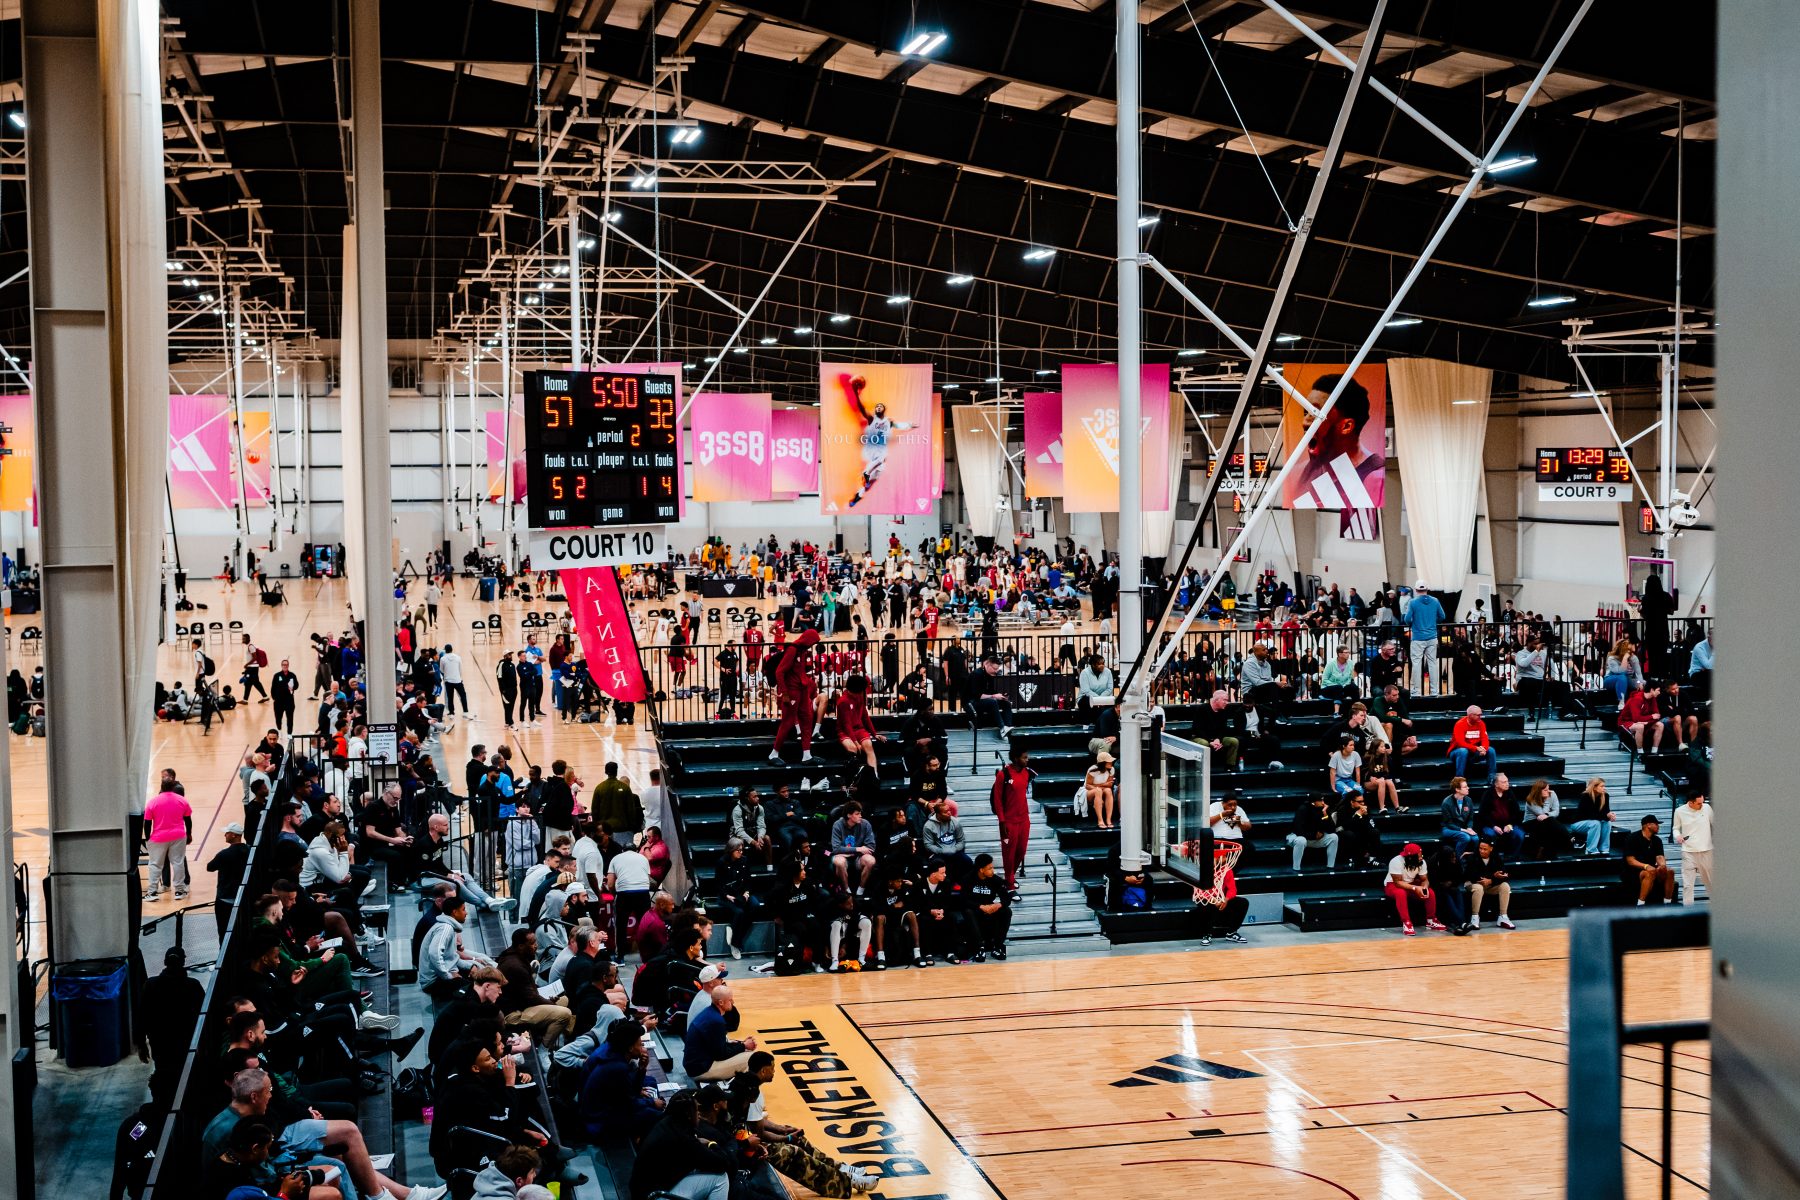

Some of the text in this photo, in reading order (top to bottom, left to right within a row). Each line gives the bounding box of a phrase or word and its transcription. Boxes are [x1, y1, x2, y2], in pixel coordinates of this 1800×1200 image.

[544, 376, 568, 391] Home
[645, 380, 672, 395] Guests
[592, 376, 638, 408] 5:50
[545, 396, 573, 427] 57
[650, 398, 674, 429] 32
[597, 430, 624, 444] period
[631, 424, 641, 446] 2
[824, 434, 929, 445] YOU GOT THIS
[699, 431, 764, 466] 3SSB
[545, 454, 565, 468] fouls
[598, 452, 624, 469] player
[655, 454, 674, 467] fouls
[1568, 450, 1604, 464] 13:29
[1541, 458, 1559, 473] 31
[1610, 458, 1629, 474] 39
[1597, 470, 1604, 482] 2
[552, 476, 563, 498] 5
[576, 476, 586, 498] 2
[662, 476, 672, 494] 4
[1554, 486, 1616, 498] COURT 9
[549, 510, 566, 520] won
[602, 506, 622, 521] game
[659, 506, 674, 516] won
[550, 532, 654, 560] COURT 10
[757, 1020, 931, 1178] BASKETBALL
